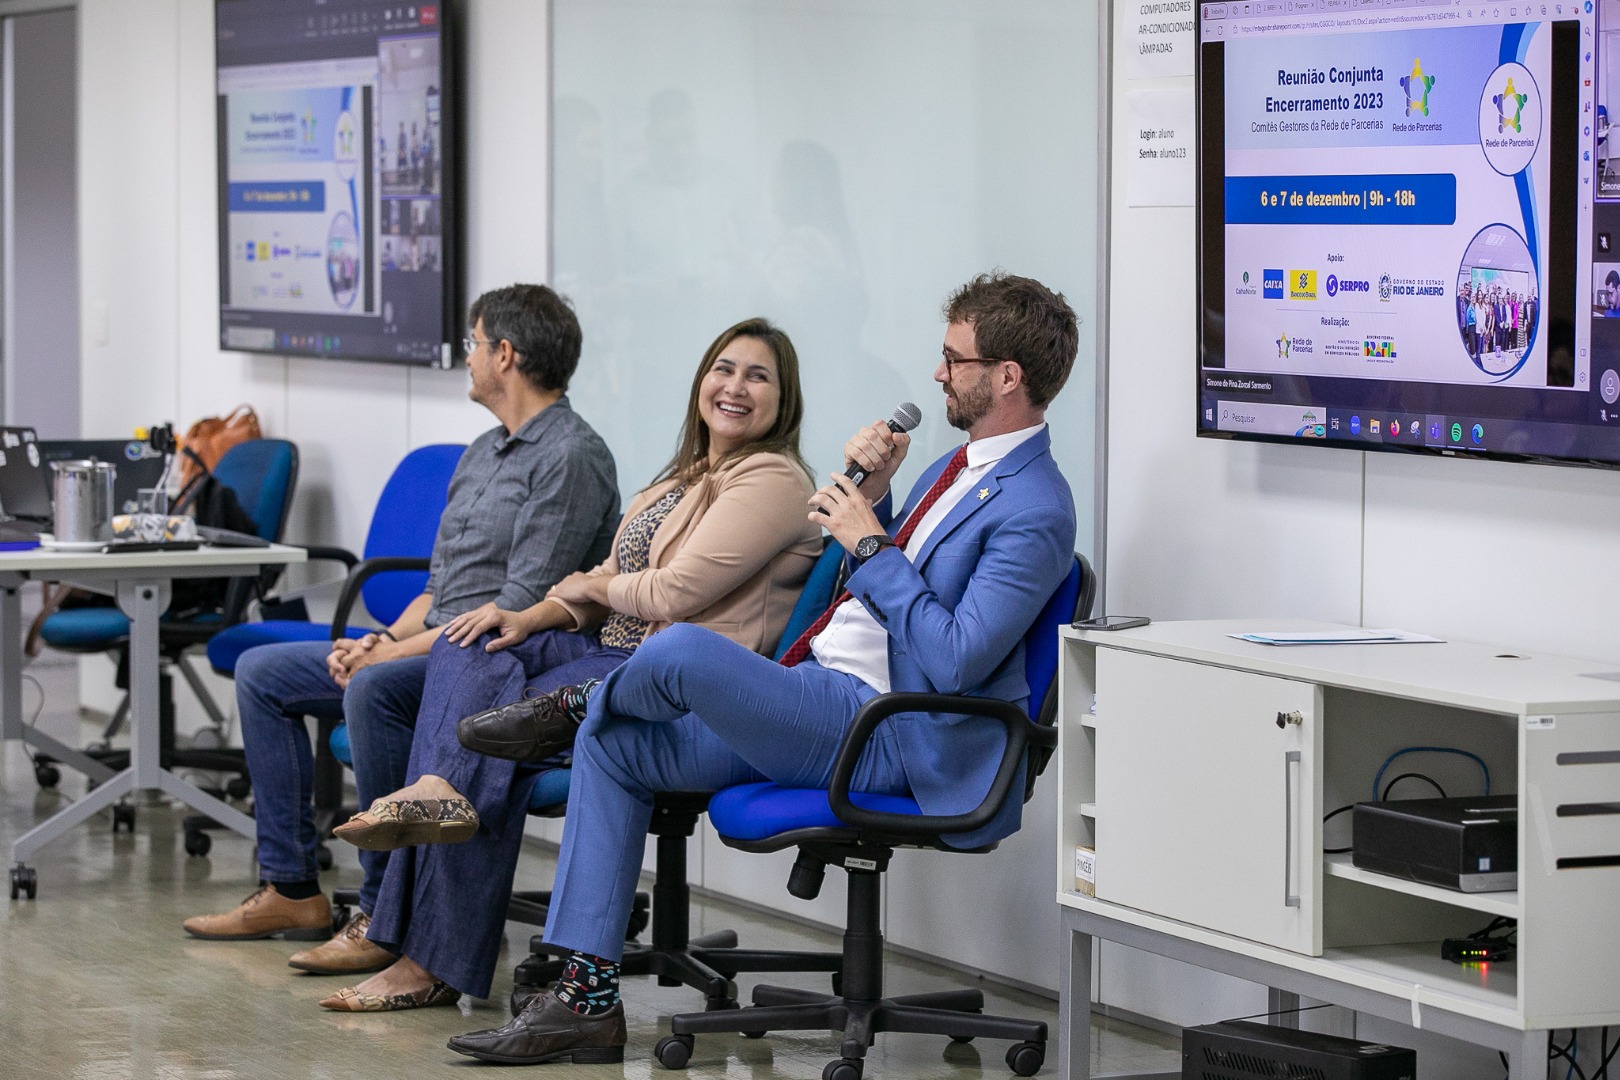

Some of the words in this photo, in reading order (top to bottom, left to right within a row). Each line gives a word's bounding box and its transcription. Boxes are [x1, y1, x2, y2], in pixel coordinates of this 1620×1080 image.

[1140, 1, 1191, 15] COMPUTADORES
[1139, 42, 1173, 54] LÂMPADAS
[1278, 69, 1325, 86] Reunião
[1329, 66, 1384, 86] Conjunta
[1265, 95, 1350, 113] Encerramento
[1353, 92, 1384, 110] 2023
[1251, 121, 1278, 133] Comitês
[1279, 120, 1309, 132] Gestores
[1310, 121, 1319, 131] da
[1320, 120, 1339, 131] Rede
[1340, 119, 1350, 130] de
[1351, 118, 1384, 130] Parcerias
[1393, 123, 1407, 132] Rede
[1408, 123, 1416, 132] de
[1416, 122, 1443, 132] Parcerias
[1140, 129, 1157, 141] Login:
[1158, 128, 1175, 139] aluno
[1486, 139, 1500, 148] Rede
[1500, 139, 1508, 148] de
[1509, 138, 1535, 147] Parcerias
[1139, 148, 1158, 159] Senha:
[1160, 147, 1187, 158] aluno123
[1261, 191, 1268, 206] 6
[1270, 196, 1277, 206] e
[1280, 191, 1287, 206] 7
[1290, 191, 1303, 206] de
[1306, 191, 1361, 206] dezembro
[1370, 190, 1384, 206] 9h
[1394, 190, 1416, 206] 18h
[1327, 253, 1345, 263] Apoio:
[1264, 280, 1283, 289] CAIXA
[1340, 280, 1369, 292] SERPRO
[1393, 286, 1404, 295] RIO
[1406, 287, 1414, 295] DE
[1416, 287, 1444, 296] JANEIRO
[1321, 317, 1350, 327] Realização:
[1292, 337, 1304, 345] Rede
[1292, 344, 1313, 354] Parcerias
[1206, 378, 1222, 386] Simone
[1223, 379, 1228, 387] de
[1229, 380, 1238, 388] Pina
[1251, 381, 1271, 390] Sarmento
[1232, 413, 1256, 424] Pesquisar
